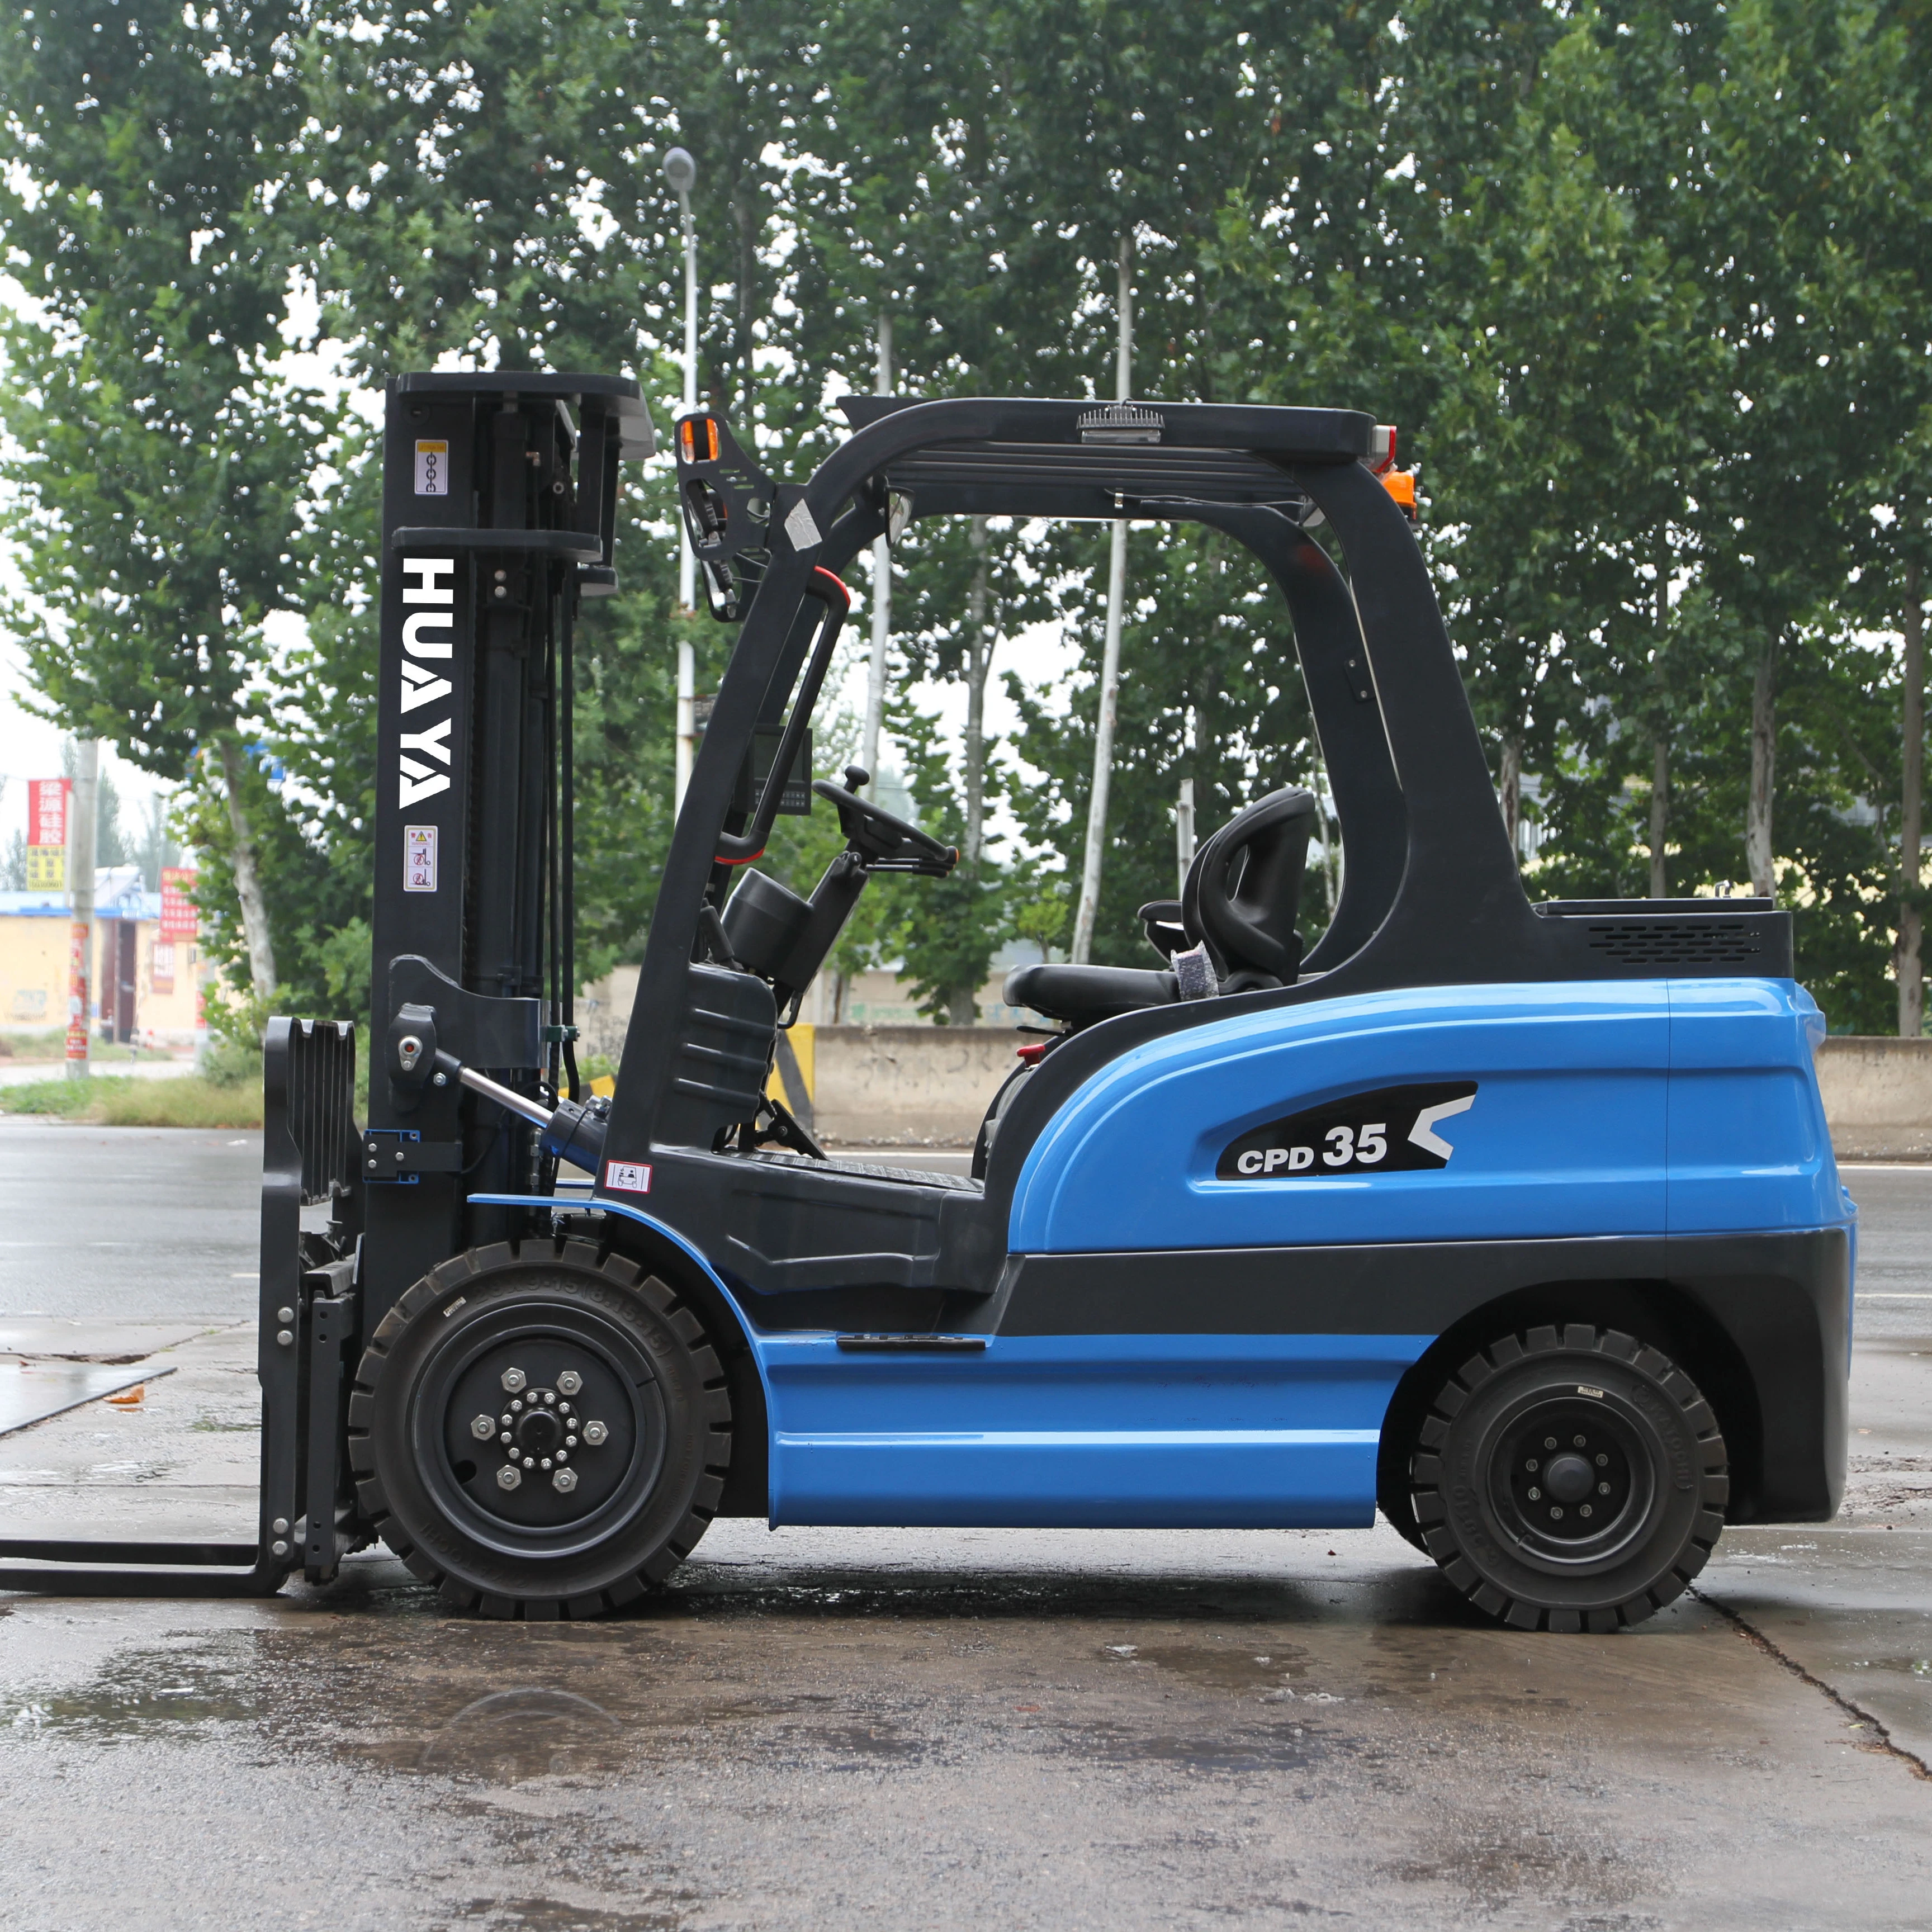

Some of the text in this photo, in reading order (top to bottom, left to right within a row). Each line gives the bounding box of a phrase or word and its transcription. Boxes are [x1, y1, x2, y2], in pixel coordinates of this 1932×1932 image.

[399, 558, 454, 809] HUAYA
[1237, 1123, 1387, 1174] CPD 35
